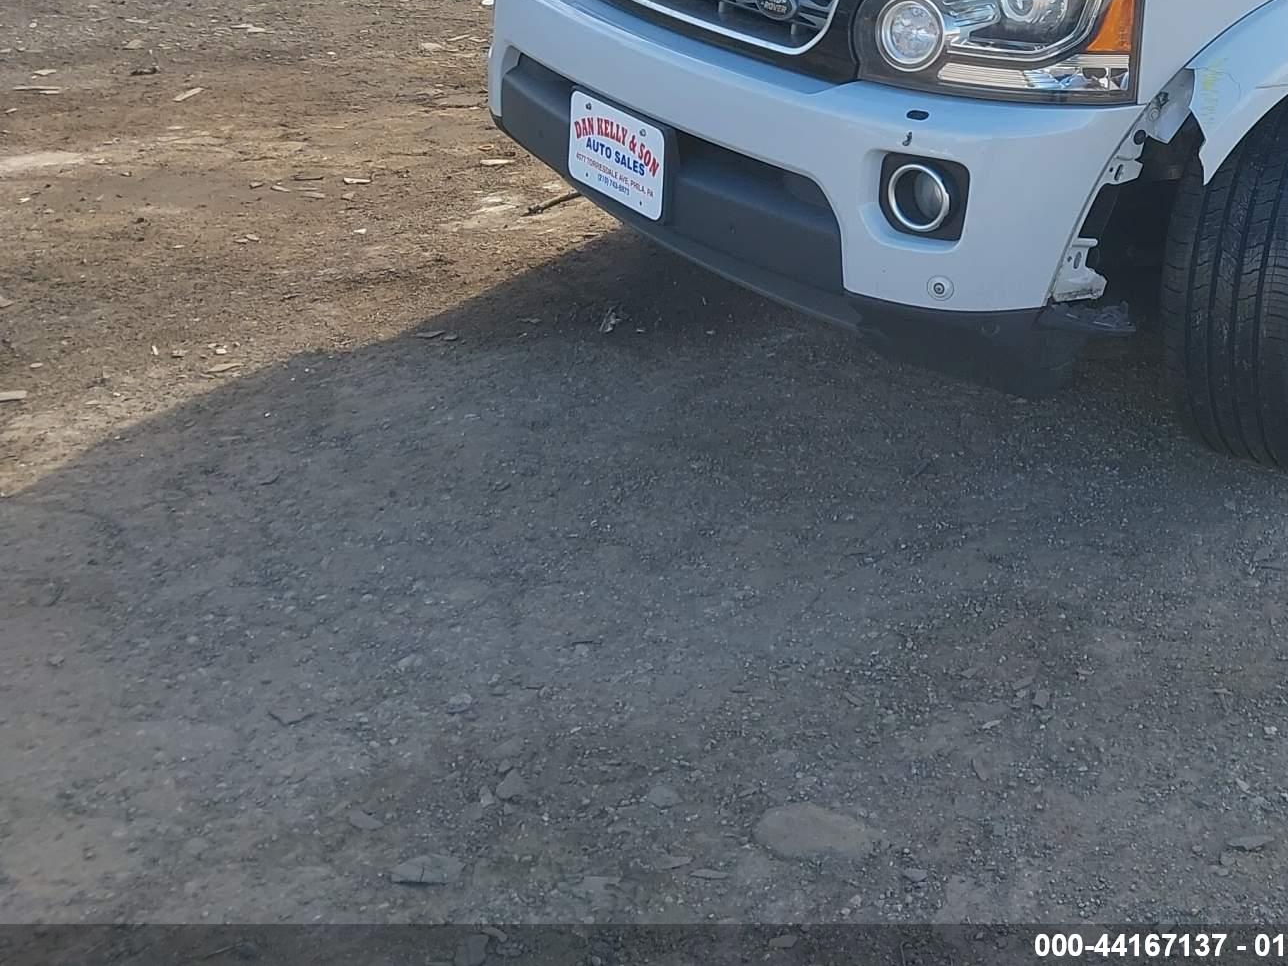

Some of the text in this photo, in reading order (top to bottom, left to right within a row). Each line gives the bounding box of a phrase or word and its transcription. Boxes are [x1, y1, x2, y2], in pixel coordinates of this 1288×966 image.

[763, 1, 787, 14] ROVER
[574, 117, 659, 178] DAN KELLY & SON
[586, 137, 645, 176] AUTO SALES
[646, 187, 654, 198] PA
